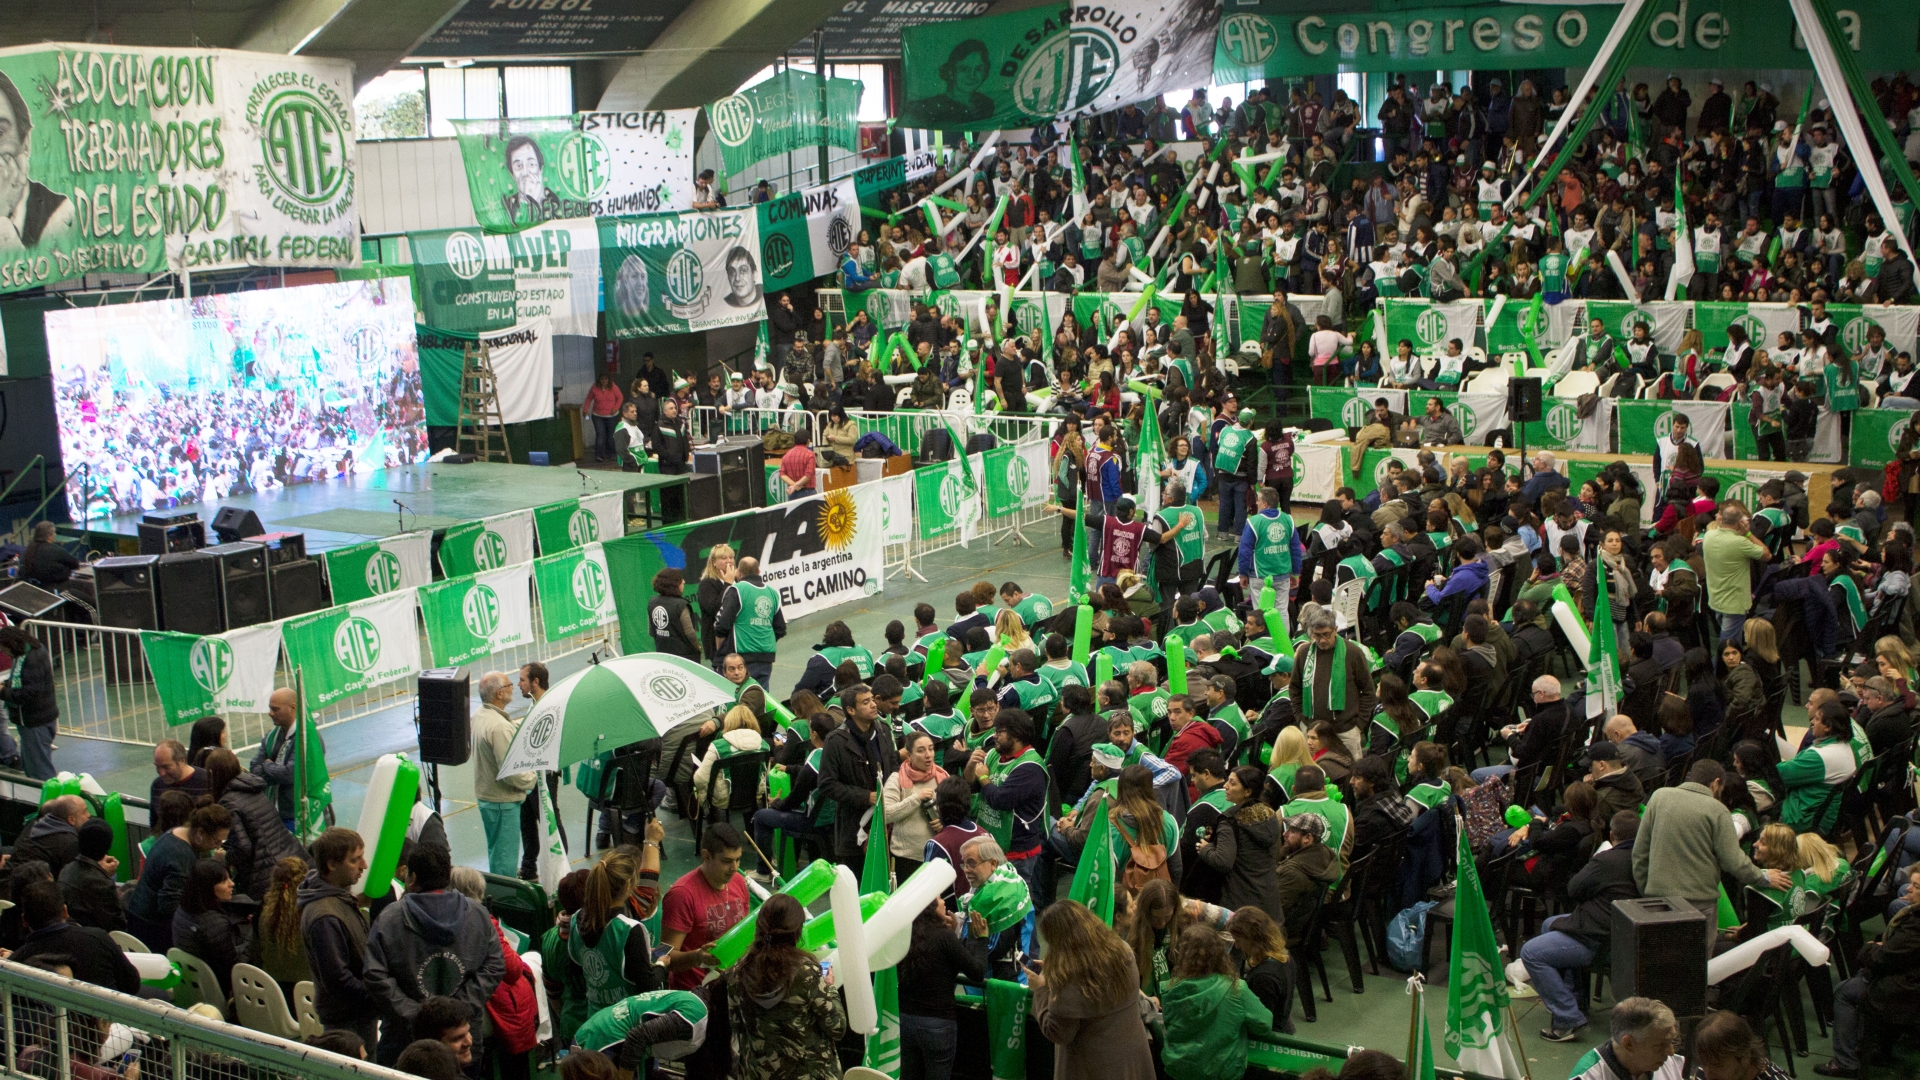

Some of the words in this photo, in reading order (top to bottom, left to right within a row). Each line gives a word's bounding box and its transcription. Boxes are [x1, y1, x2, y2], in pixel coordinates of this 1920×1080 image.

[880, 1, 990, 16] MASCULINO
[1297, 9, 1589, 56] Congreso
[1648, 0, 1730, 50] de
[1790, 9, 1862, 51] a
[1000, 5, 1138, 78] DESARROLLO
[1221, 14, 1274, 66] ATE
[56, 51, 217, 109] ASOCIACION
[1018, 30, 1115, 115] ATE
[245, 71, 299, 126] FORTALECER
[300, 73, 317, 90] EL
[316, 83, 352, 132] ESTADO
[717, 97, 750, 143] ATE
[60, 117, 226, 174] TRABAJADORES
[268, 99, 339, 196] ATE
[559, 135, 607, 199] ATE
[74, 183, 125, 239] DEL
[131, 183, 228, 238] ESTADO
[252, 164, 275, 201] PARA
[272, 195, 321, 225] LIBERAR
[323, 208, 336, 225] LA
[527, 195, 604, 222] DERECHOS
[607, 184, 662, 214] HUMANOS
[768, 187, 839, 225] COMUNAS
[181, 235, 272, 267] CAPITAL
[277, 235, 354, 262] FEDERAL
[616, 214, 743, 249] MIGRACIONES
[449, 237, 483, 278] ATE
[668, 251, 701, 300] ATE
[455, 289, 528, 306] CONSTRUYENDO
[530, 288, 565, 302] ESTADO
[487, 307, 500, 321] EN
[501, 306, 515, 320] LA
[517, 305, 552, 319] CIUDAD
[1547, 405, 1582, 440] ATE
[1298, 491, 1323, 500] Federal
[368, 553, 400, 595] ATE
[788, 564, 800, 577] de
[801, 561, 810, 574] la
[812, 550, 853, 572] argentina
[575, 562, 606, 610] ATE
[780, 586, 802, 607] EL
[803, 566, 867, 600] CAMINO
[467, 586, 500, 637] ATE
[558, 622, 579, 634] Secc.
[339, 618, 380, 670] ATE
[449, 653, 470, 666] Secc.
[318, 689, 344, 703] Secc.
[344, 675, 375, 692] Capital
[377, 664, 411, 680] Federal
[652, 677, 684, 700] ATE
[177, 706, 203, 719] Secc.
[531, 716, 554, 747] ATE
[1006, 994, 1027, 1050] Secc.
